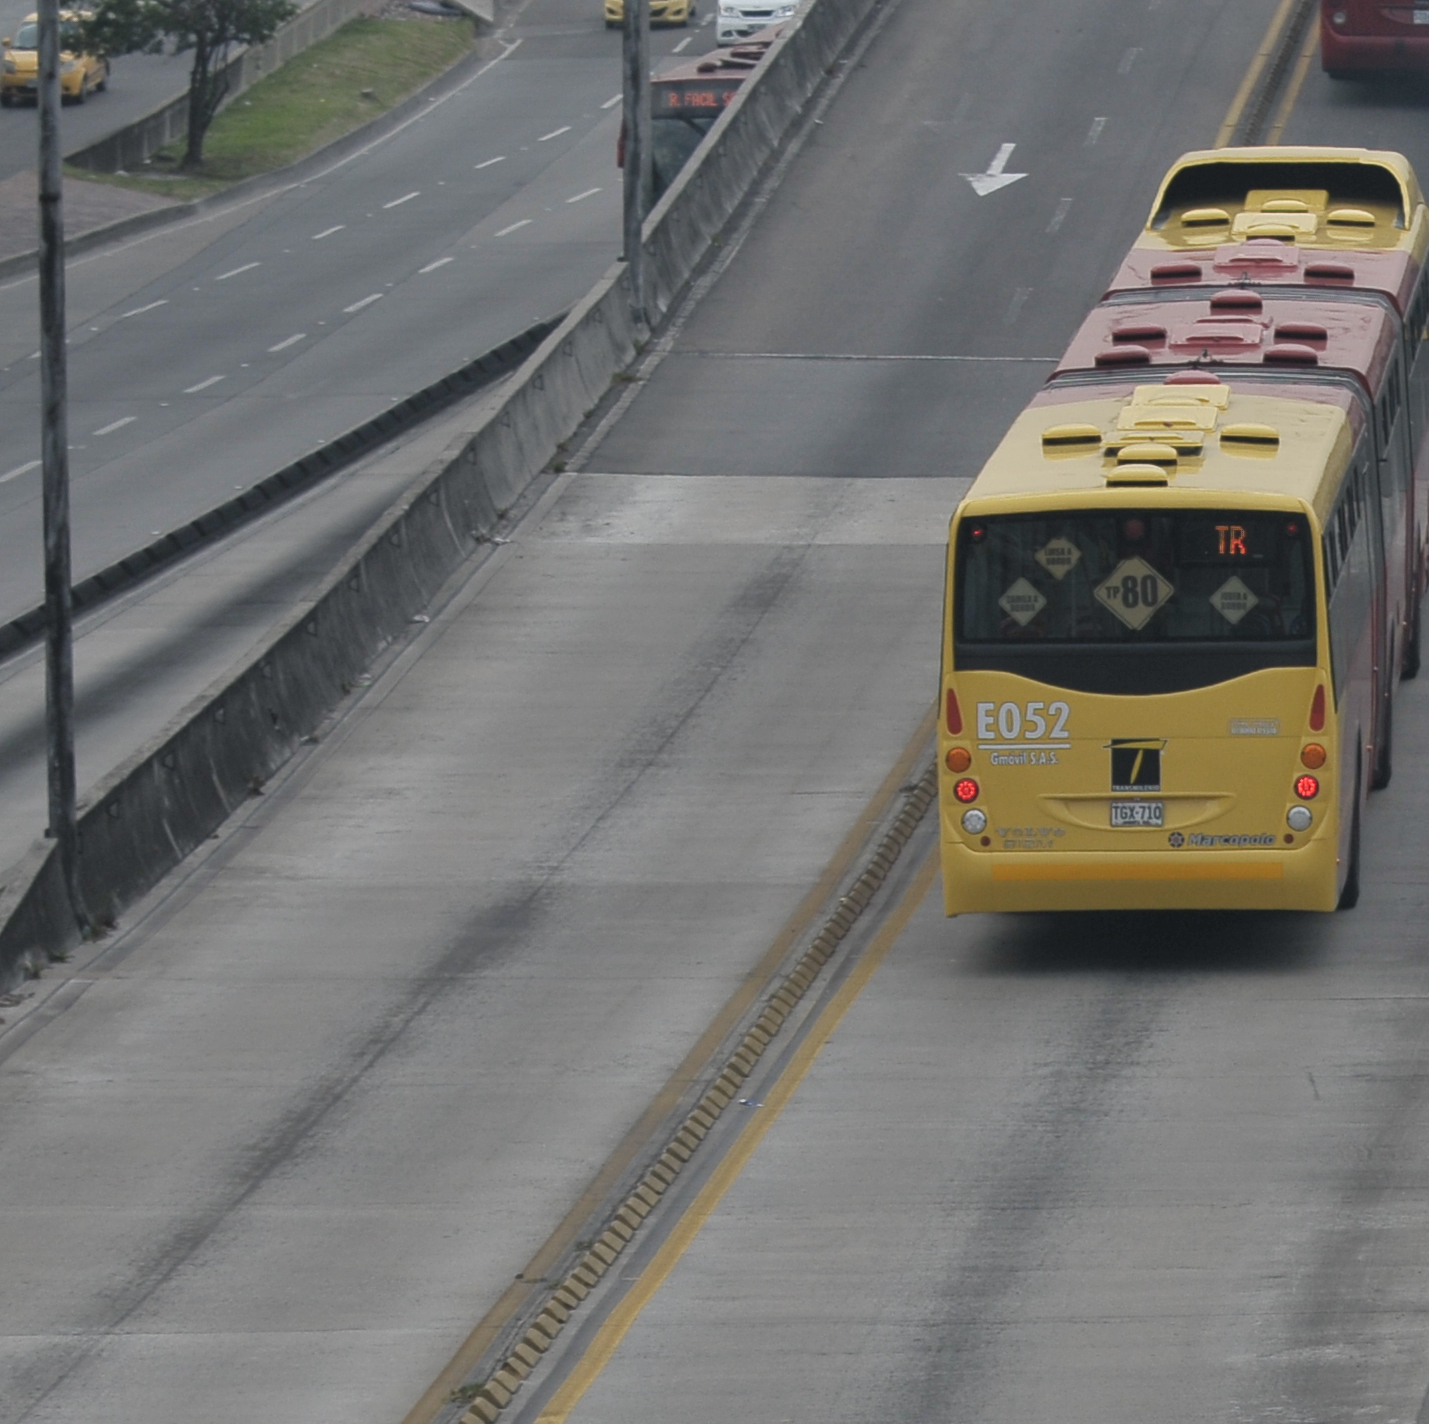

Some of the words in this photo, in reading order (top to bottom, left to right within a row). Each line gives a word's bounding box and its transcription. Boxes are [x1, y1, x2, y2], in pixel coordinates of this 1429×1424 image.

[1215, 525, 1247, 555] TR
[1105, 586, 1120, 600] TP
[1121, 575, 1159, 608] 80
[976, 701, 1071, 740] E052
[1029, 751, 1059, 765] S.A.S.
[1187, 833, 1276, 848] Marcopolo
